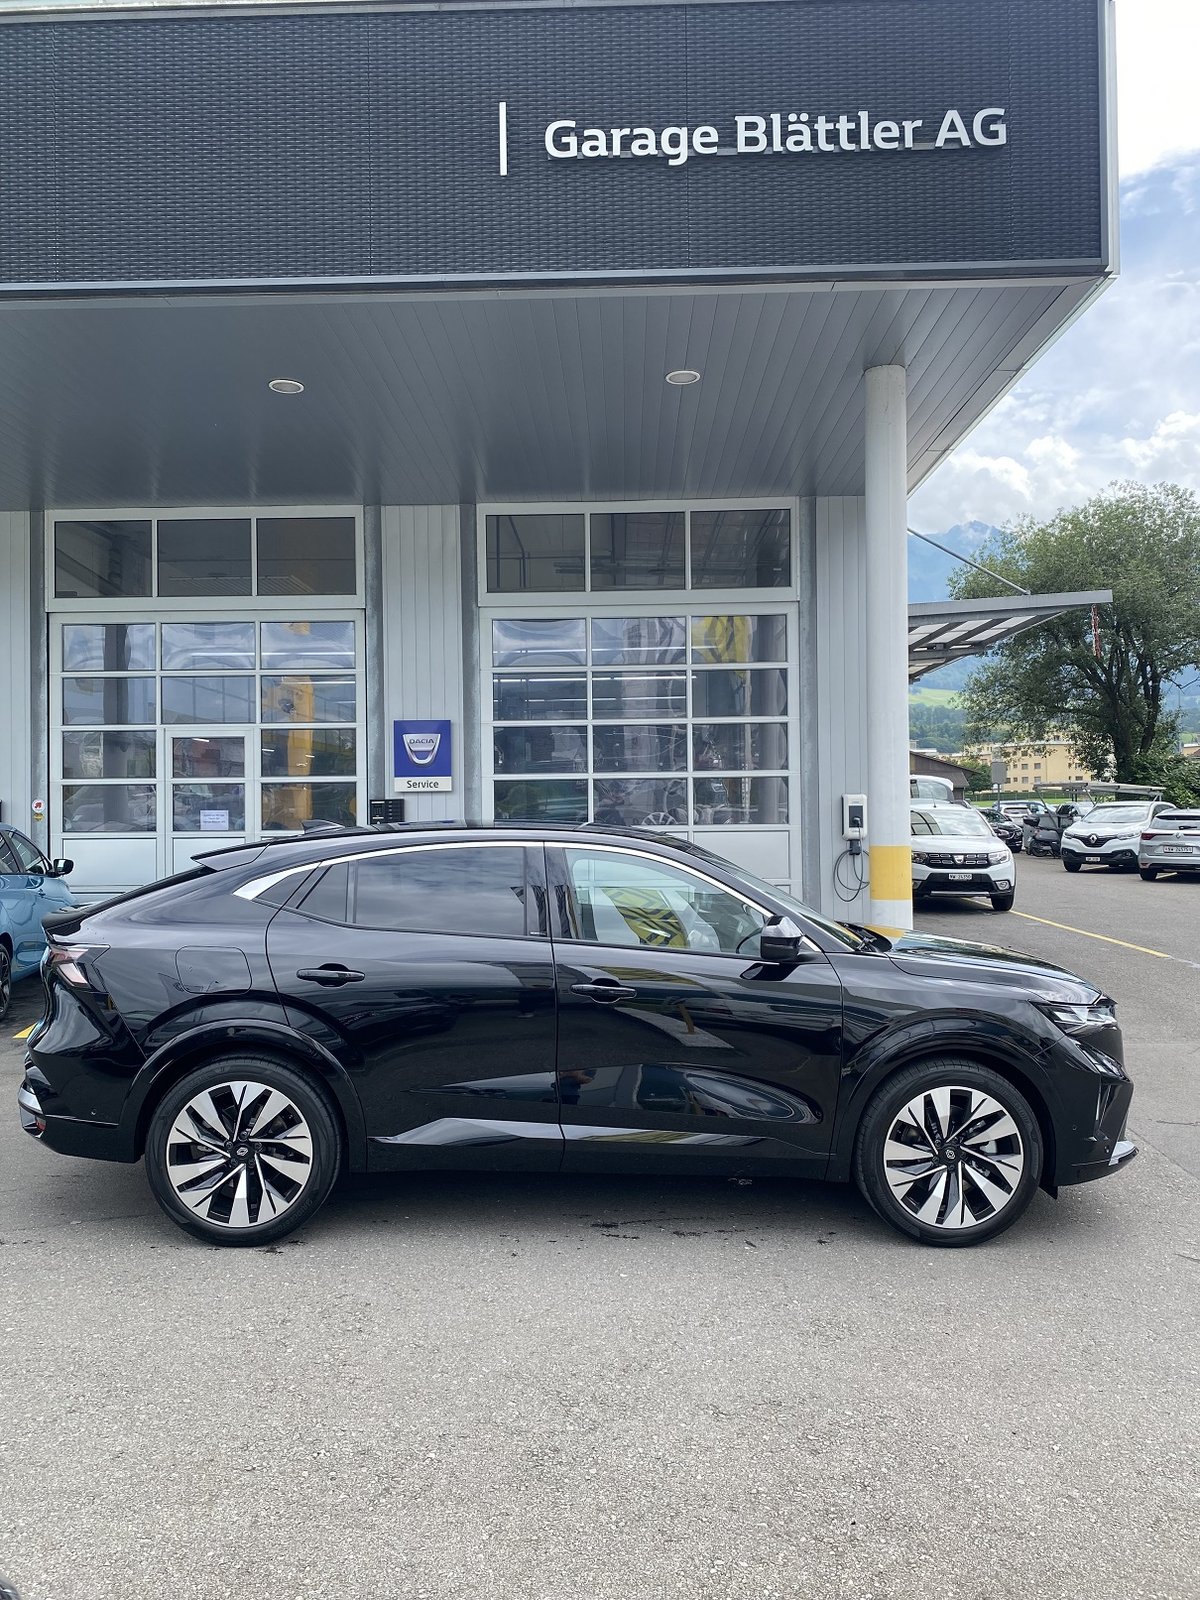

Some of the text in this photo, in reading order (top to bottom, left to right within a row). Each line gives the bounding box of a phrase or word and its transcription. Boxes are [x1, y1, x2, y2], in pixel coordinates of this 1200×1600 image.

[545, 107, 1007, 166] Garage Blättler AG
[406, 780, 439, 788] Service
